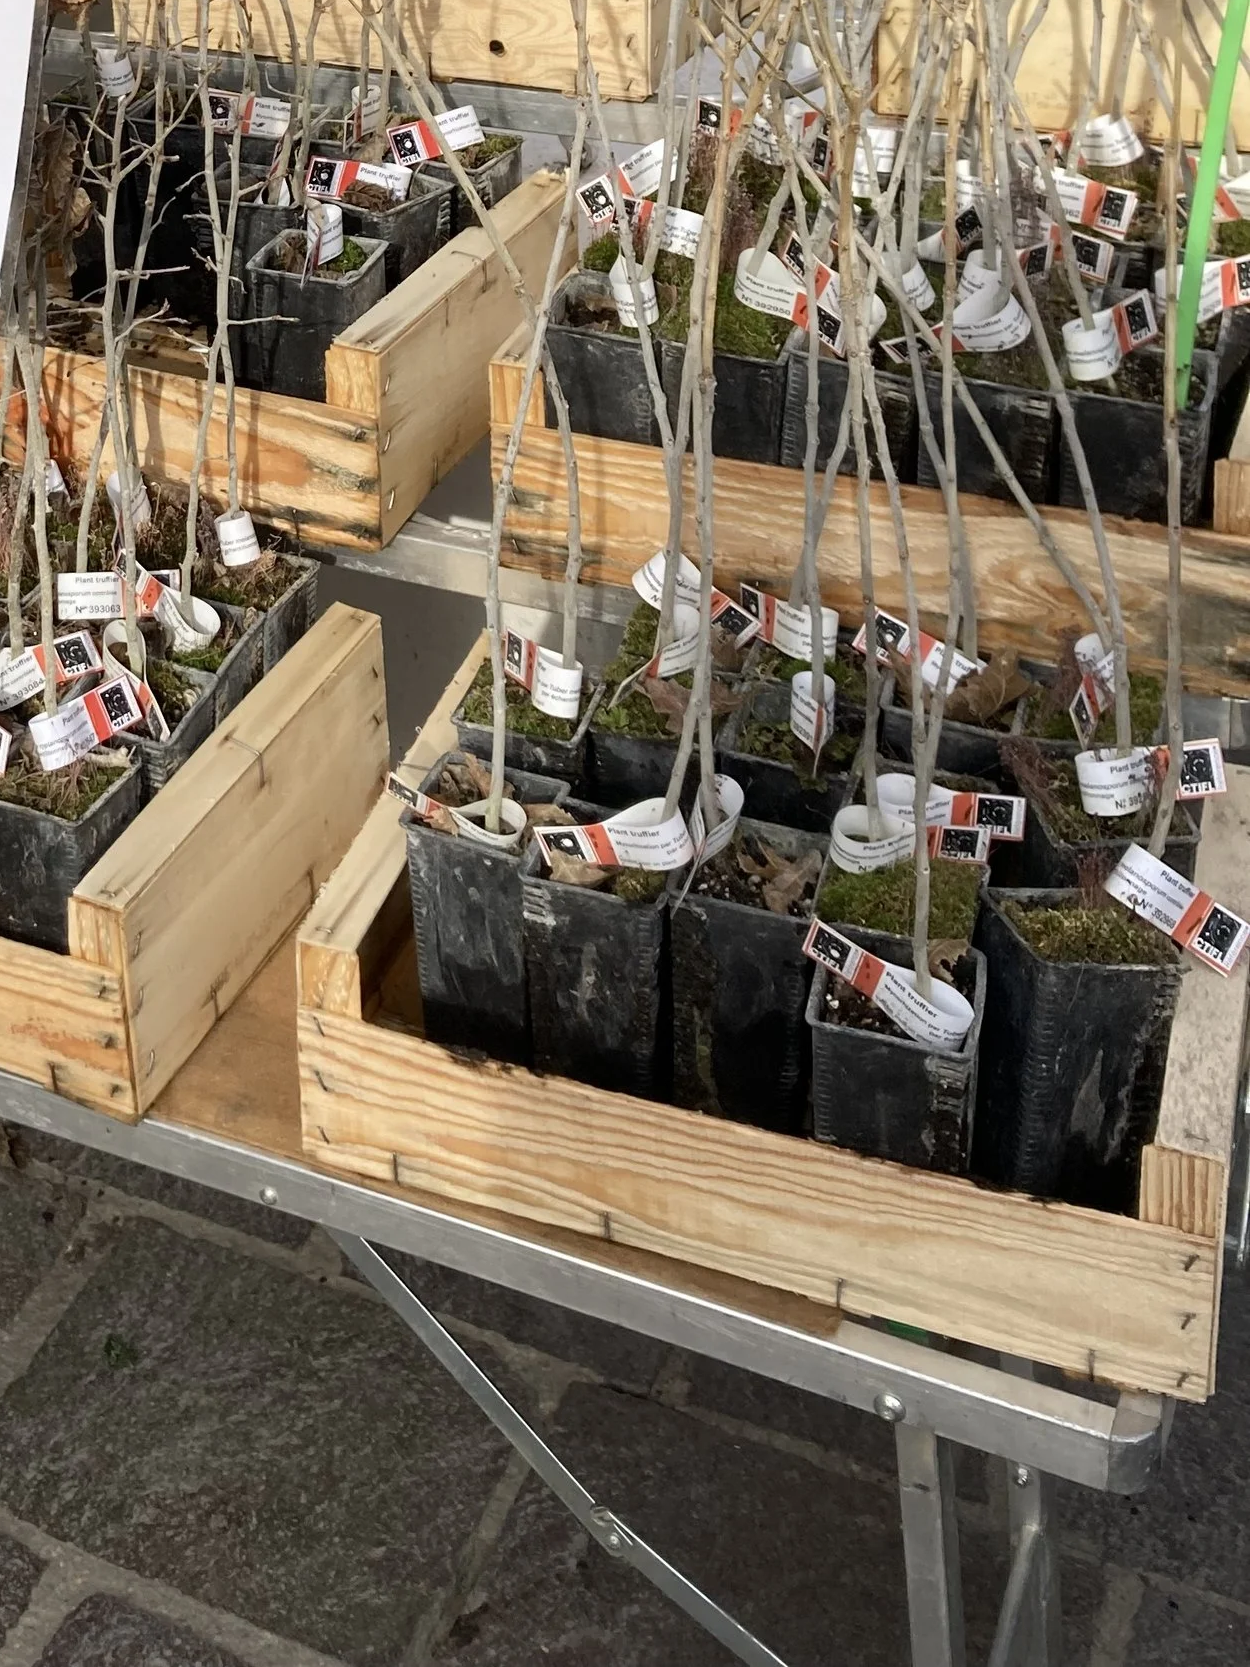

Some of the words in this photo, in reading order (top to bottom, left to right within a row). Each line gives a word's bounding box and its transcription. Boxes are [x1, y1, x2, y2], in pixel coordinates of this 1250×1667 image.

[75, 576, 94, 584] Plant
[95, 574, 119, 584] truffier
[89, 604, 121, 614] 393063
[1182, 782, 1217, 793] CTIFL
[1160, 869, 1180, 887] Plant
[1196, 937, 1225, 964] CTIFL
[885, 970, 907, 995] Plant
[907, 991, 938, 1019] truffier
